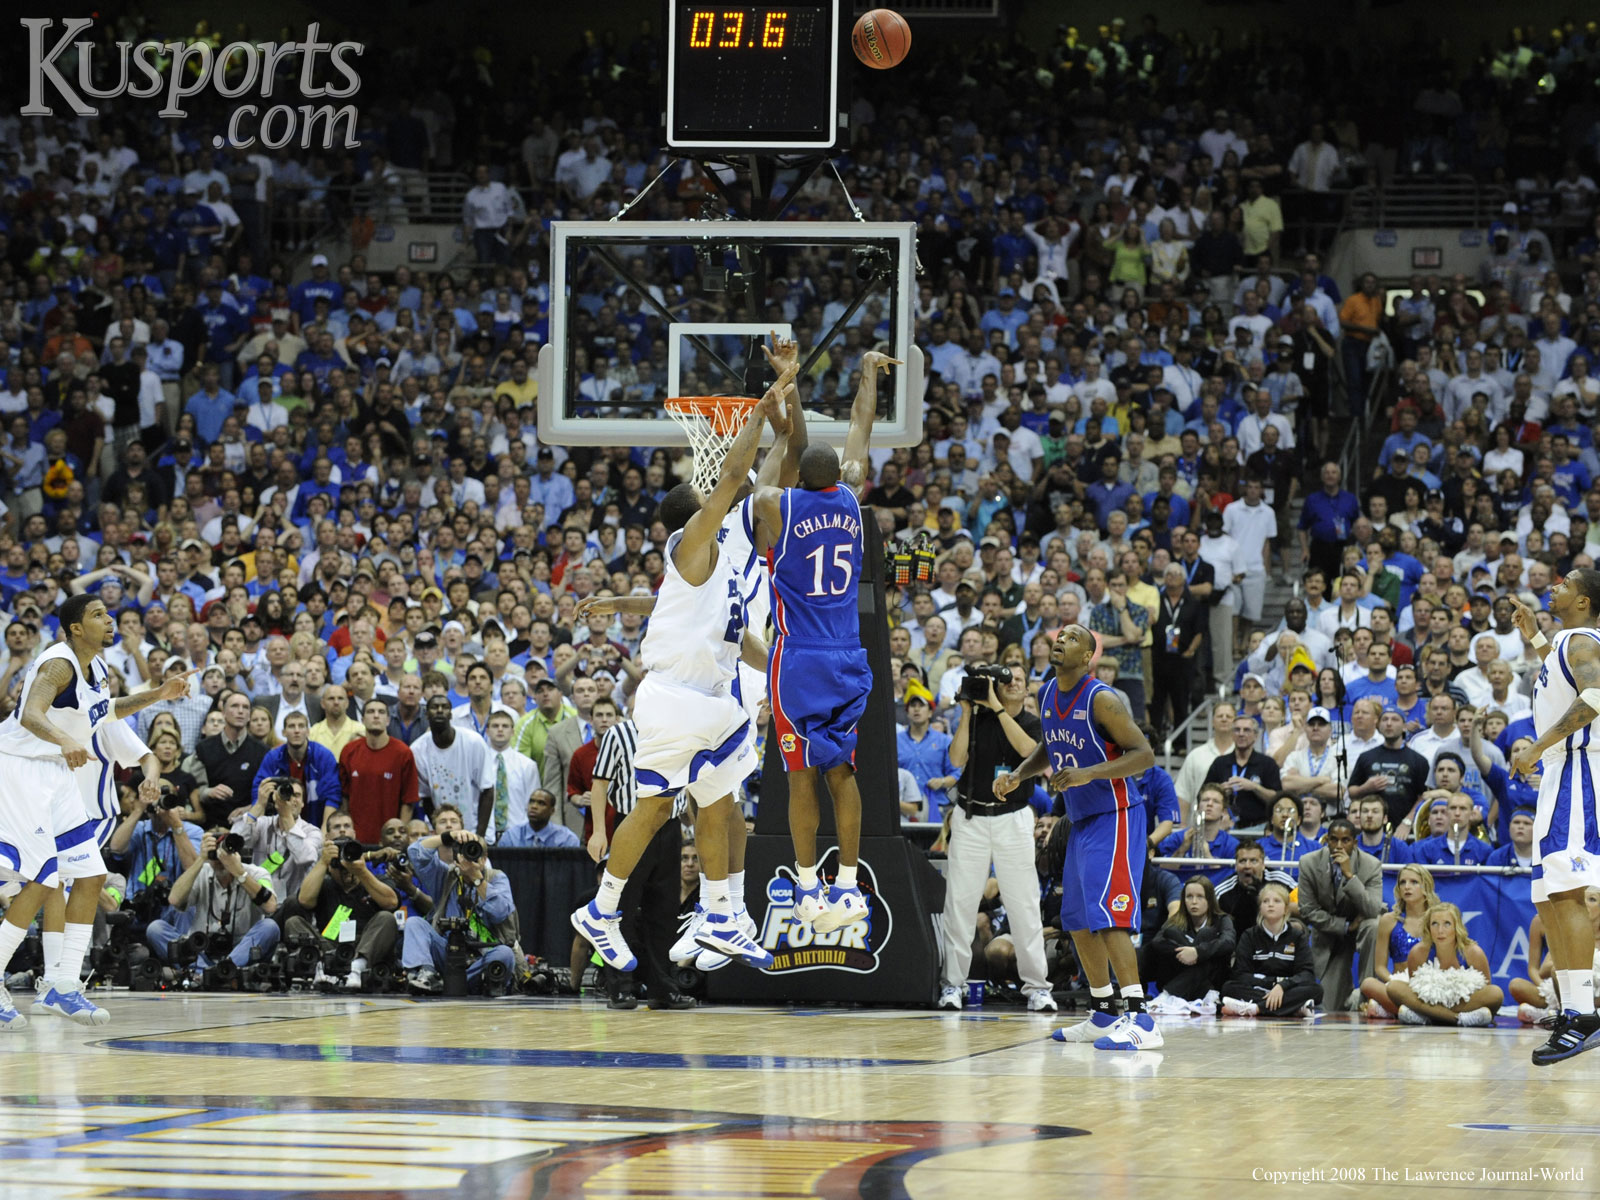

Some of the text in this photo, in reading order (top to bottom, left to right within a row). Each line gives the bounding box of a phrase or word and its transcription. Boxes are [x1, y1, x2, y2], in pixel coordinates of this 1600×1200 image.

[690, 12, 787, 48] 03.6
[863, 19, 884, 61] Wilson
[793, 513, 860, 539] CHALMERS
[806, 543, 853, 596] 15
[1045, 728, 1086, 750] KANSAS
[771, 889, 793, 897] NCAA
[763, 907, 871, 950] FOUR
[794, 950, 847, 966] ANTONIO
[1099, 1001, 1109, 1009] 32
